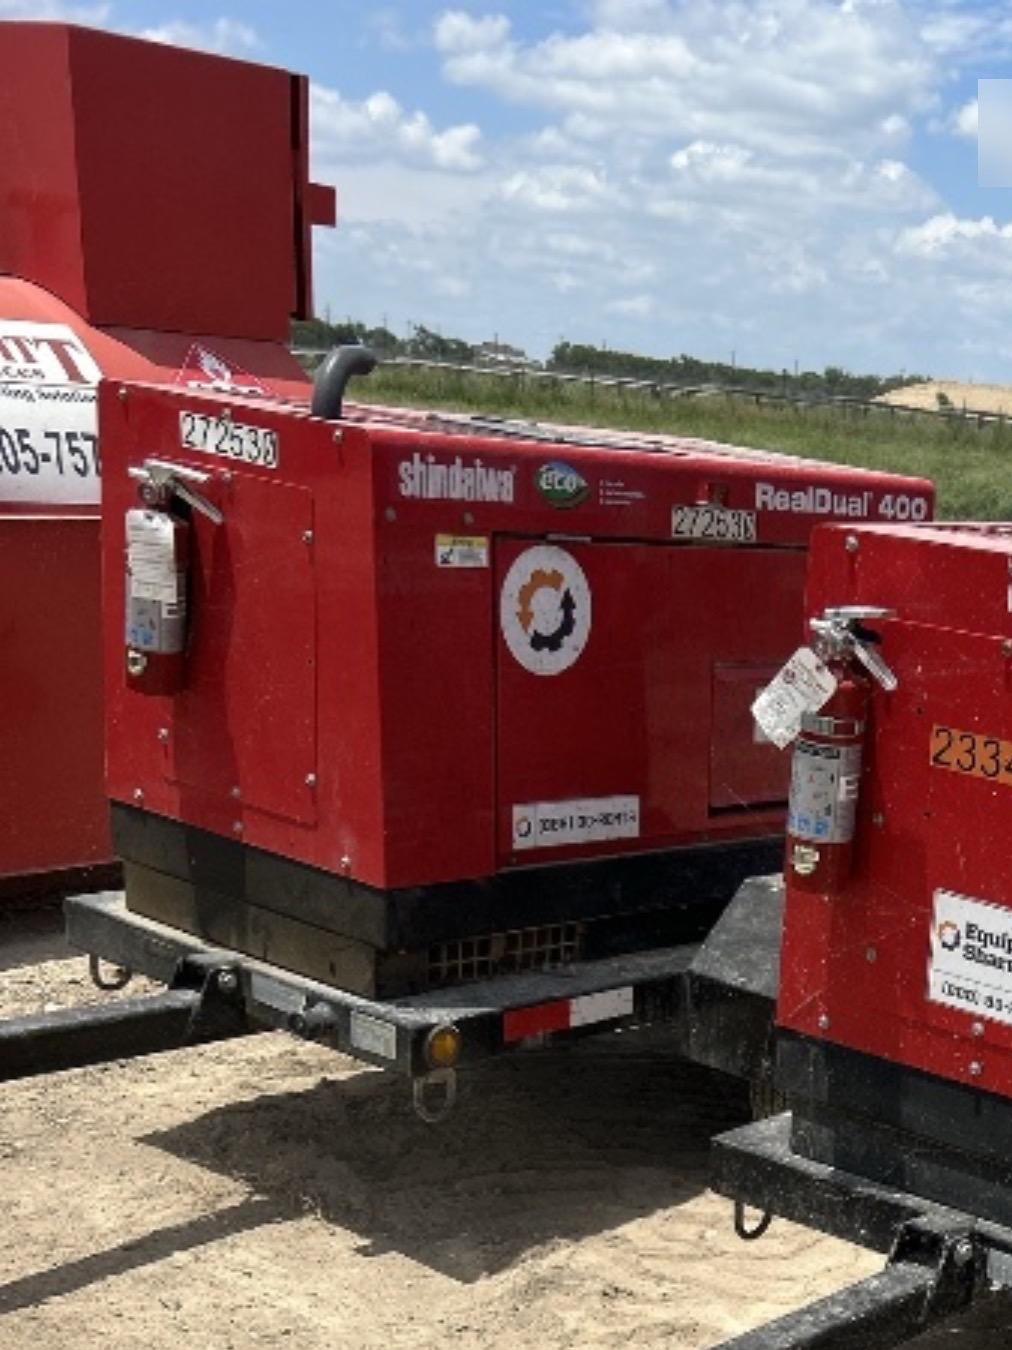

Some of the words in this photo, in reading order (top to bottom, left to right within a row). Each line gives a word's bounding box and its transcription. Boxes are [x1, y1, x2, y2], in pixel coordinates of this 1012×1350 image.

[399, 453, 515, 503] shindaiwa
[755, 482, 869, 517] RealDual
[878, 495, 927, 521] 400
